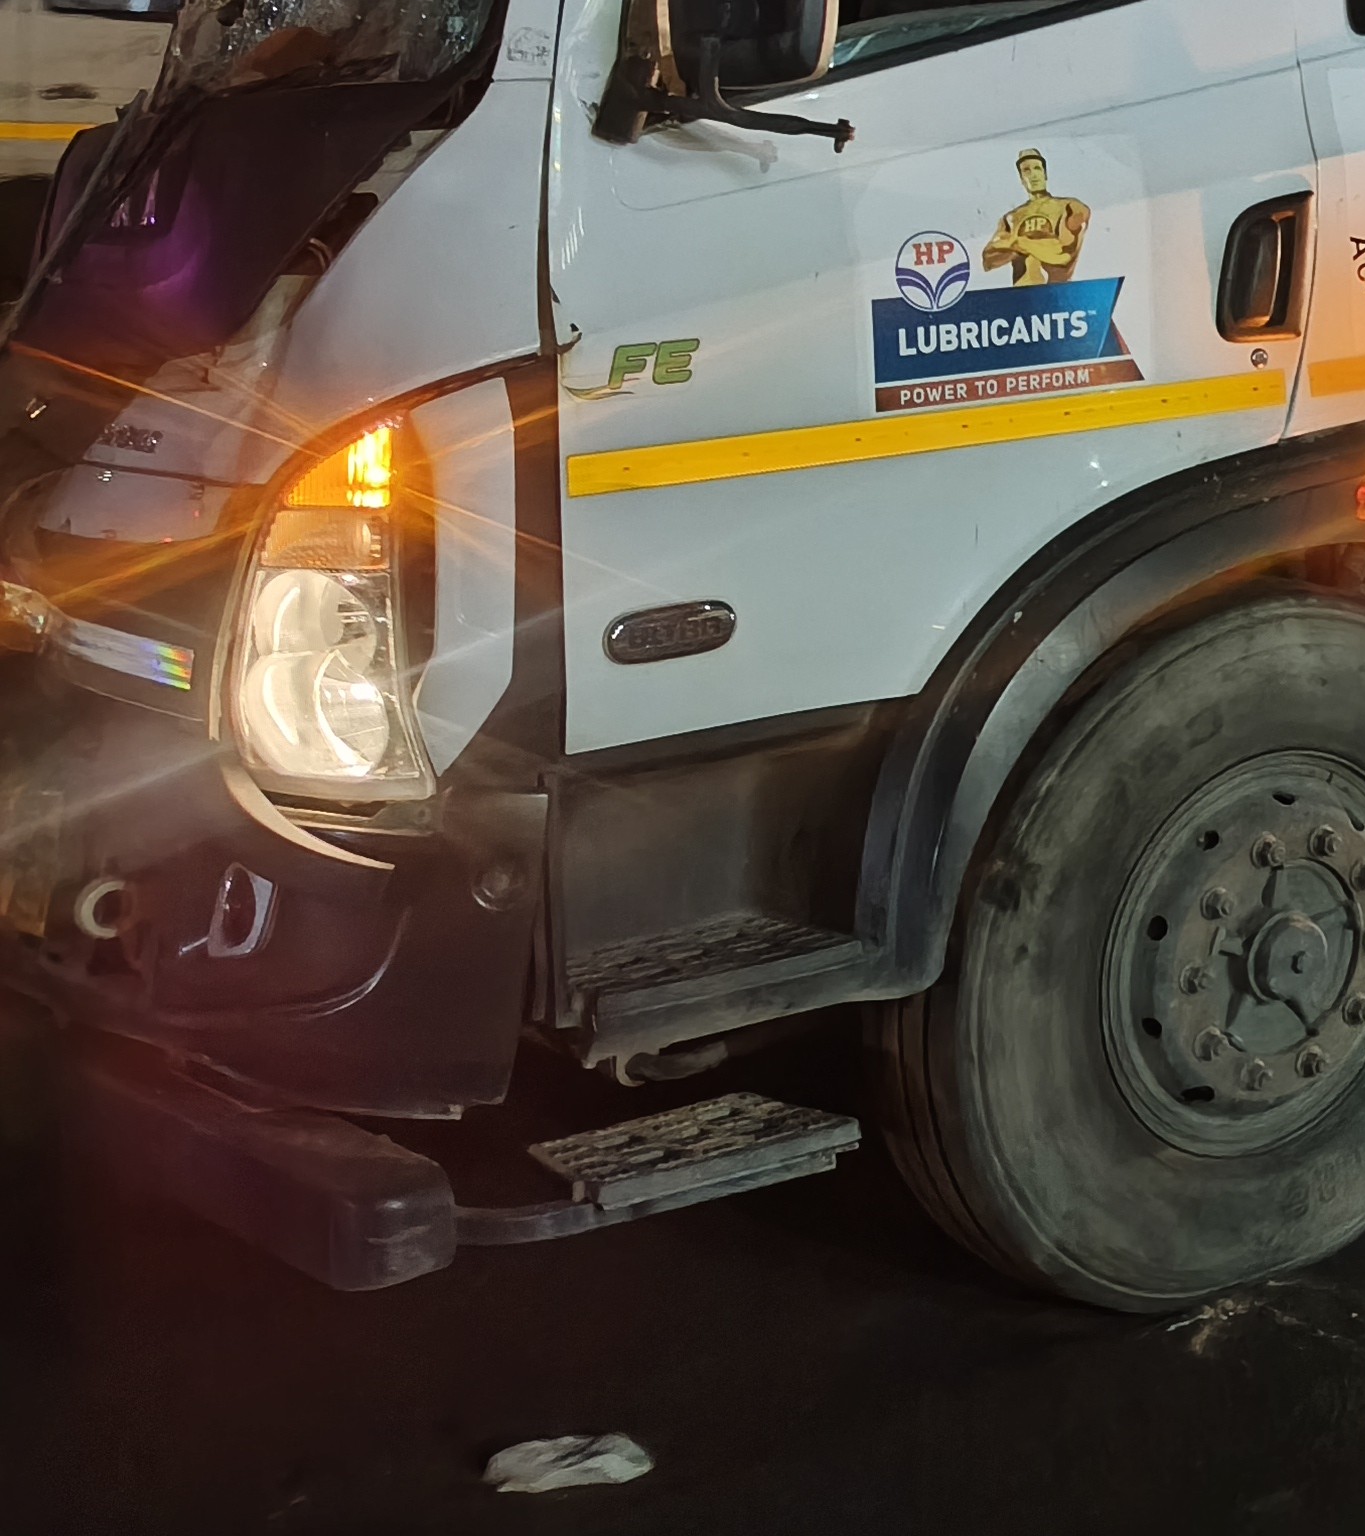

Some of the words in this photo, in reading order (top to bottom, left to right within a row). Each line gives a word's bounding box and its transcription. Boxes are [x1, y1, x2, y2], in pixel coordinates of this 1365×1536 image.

[1024, 217, 1047, 232] HP
[911, 240, 955, 266] HP
[899, 310, 1089, 356] LUBRICANTS
[607, 337, 700, 390] FE
[900, 383, 968, 406] POWER
[974, 380, 999, 396] TO
[1006, 368, 1091, 394] PERFORM
